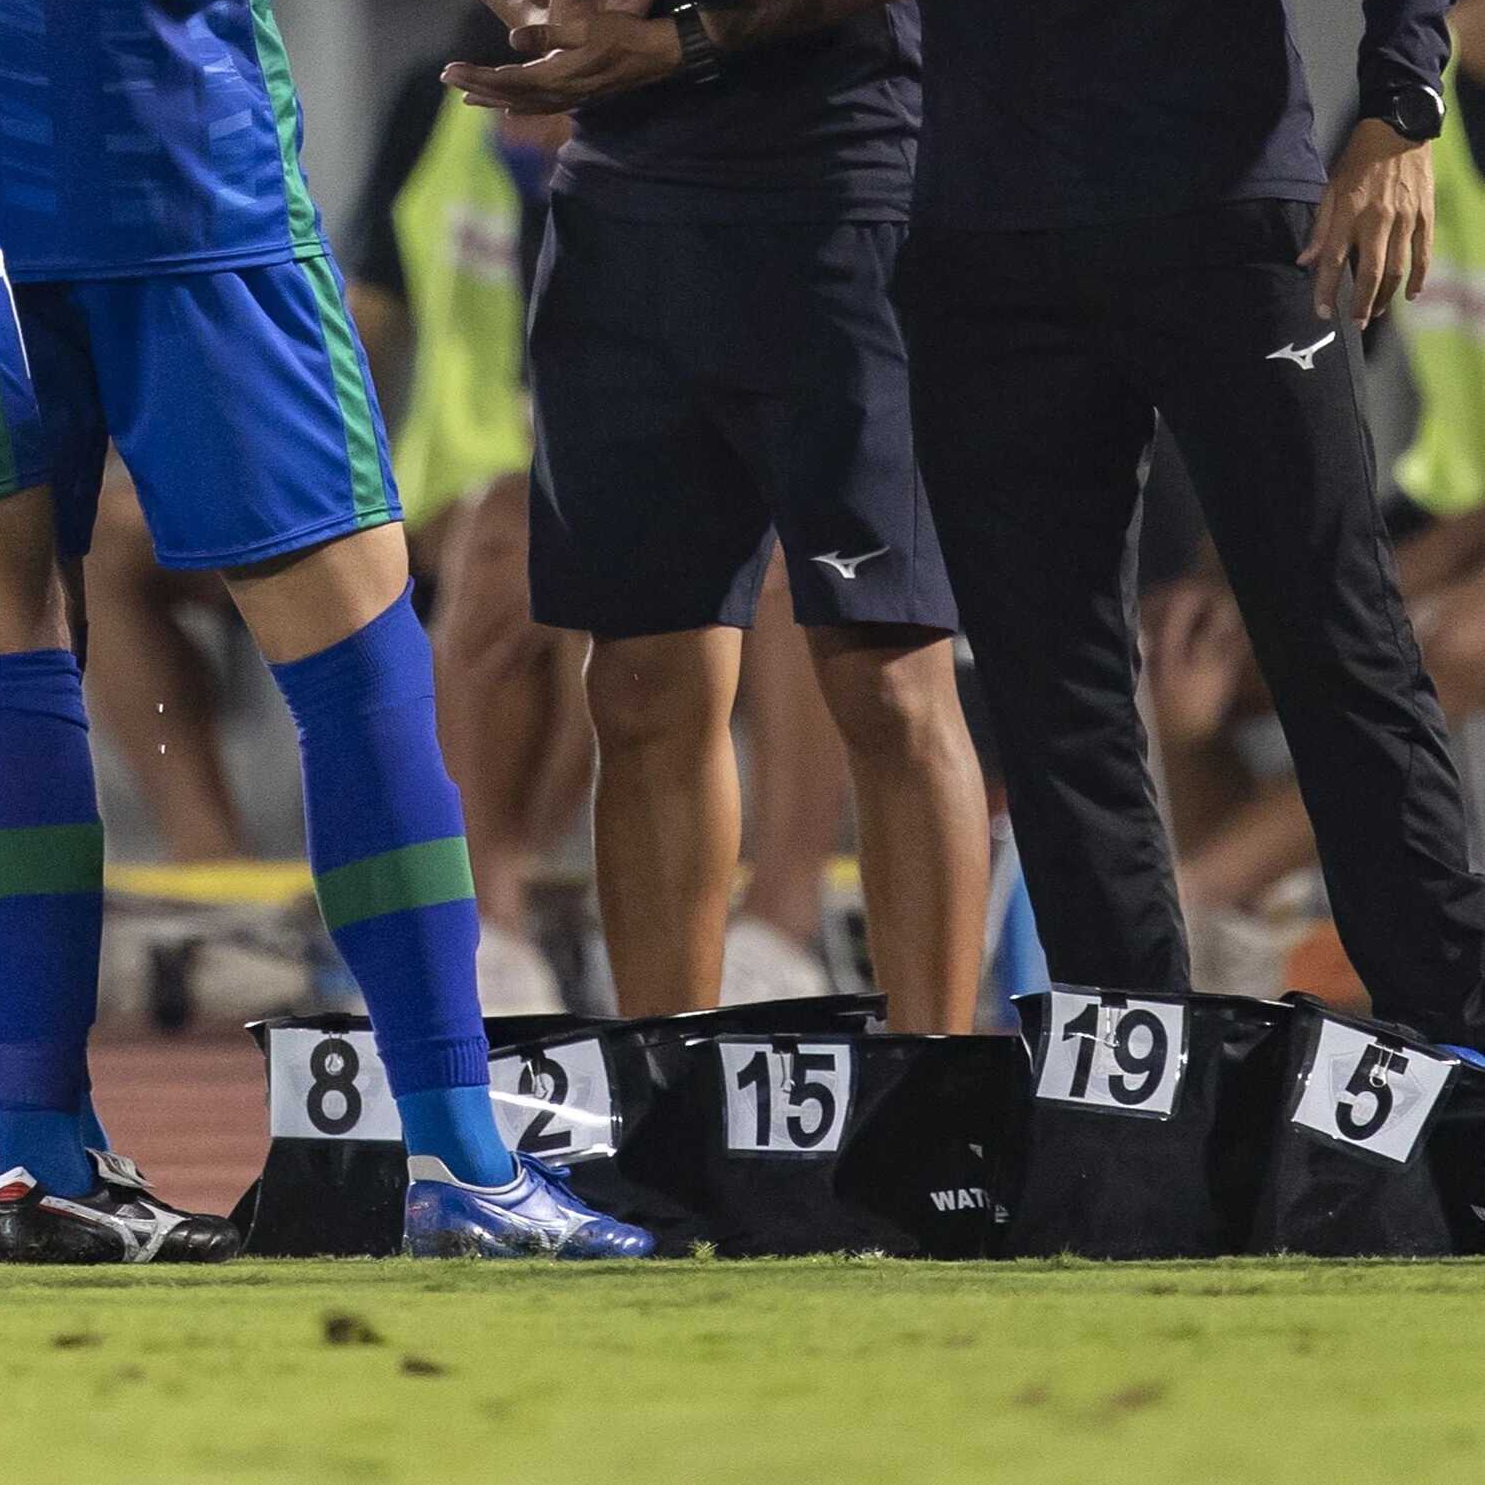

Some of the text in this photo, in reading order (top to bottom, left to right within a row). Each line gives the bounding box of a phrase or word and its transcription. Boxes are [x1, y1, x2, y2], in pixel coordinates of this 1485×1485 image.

[306, 1038, 363, 1136] 8
[517, 1052, 571, 1155] 2
[736, 1049, 836, 1149] 15
[1062, 1003, 1169, 1106] 19
[1334, 1043, 1410, 1142] 5
